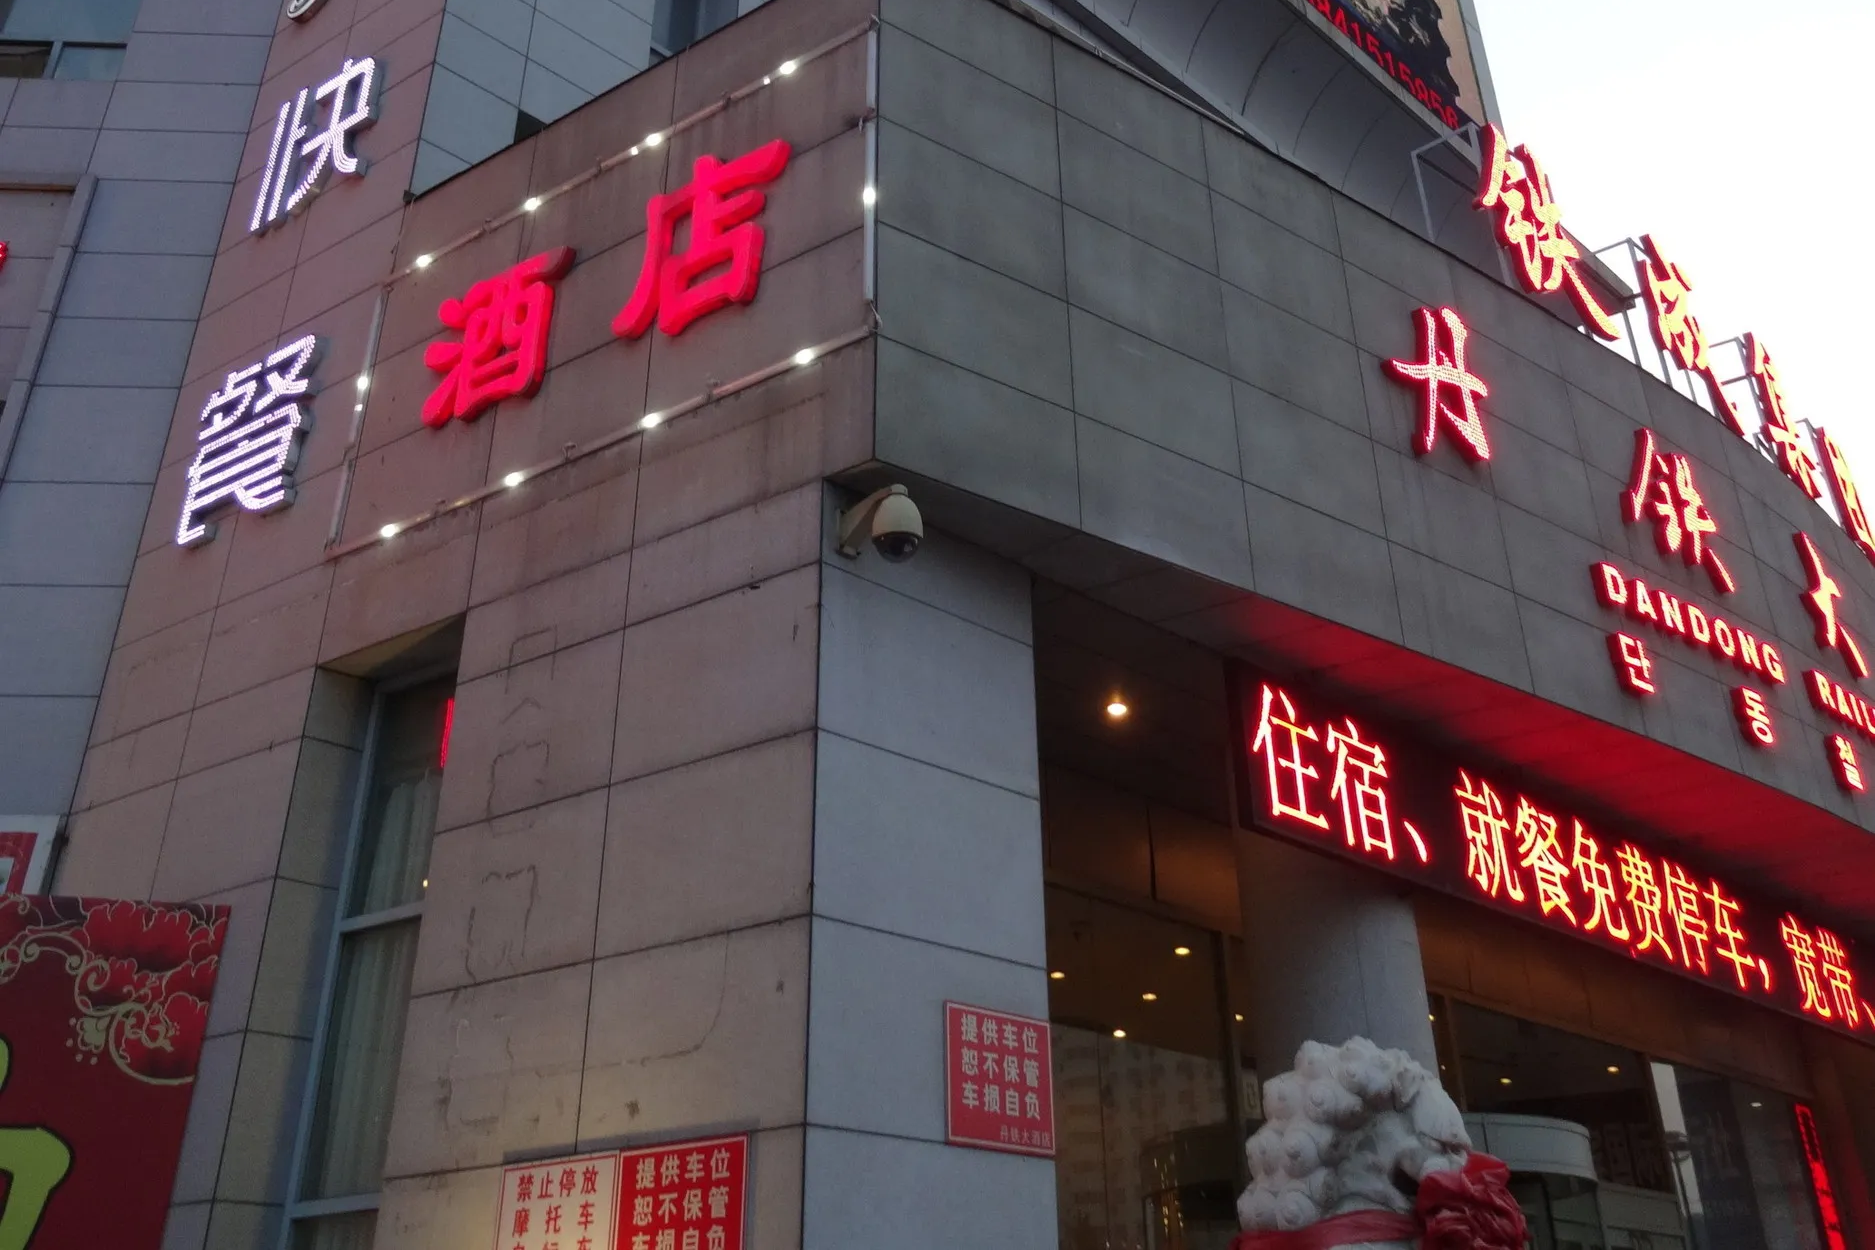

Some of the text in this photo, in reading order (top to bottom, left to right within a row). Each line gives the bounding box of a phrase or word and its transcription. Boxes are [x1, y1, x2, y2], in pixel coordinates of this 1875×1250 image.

[177, 58, 376, 546] 快餐
[421, 138, 791, 429] 酒店
[1598, 562, 1875, 736] DANDONG RAIL
[961, 1013, 1040, 1054] 提供车位
[961, 1046, 1040, 1089] 恕不保管
[962, 1081, 1041, 1121] 车损自负
[516, 1165, 600, 1203] 禁止停放
[635, 1147, 731, 1190] 提供车位
[512, 1200, 596, 1239] 摩托车
[632, 1186, 731, 1226] 恕不保管
